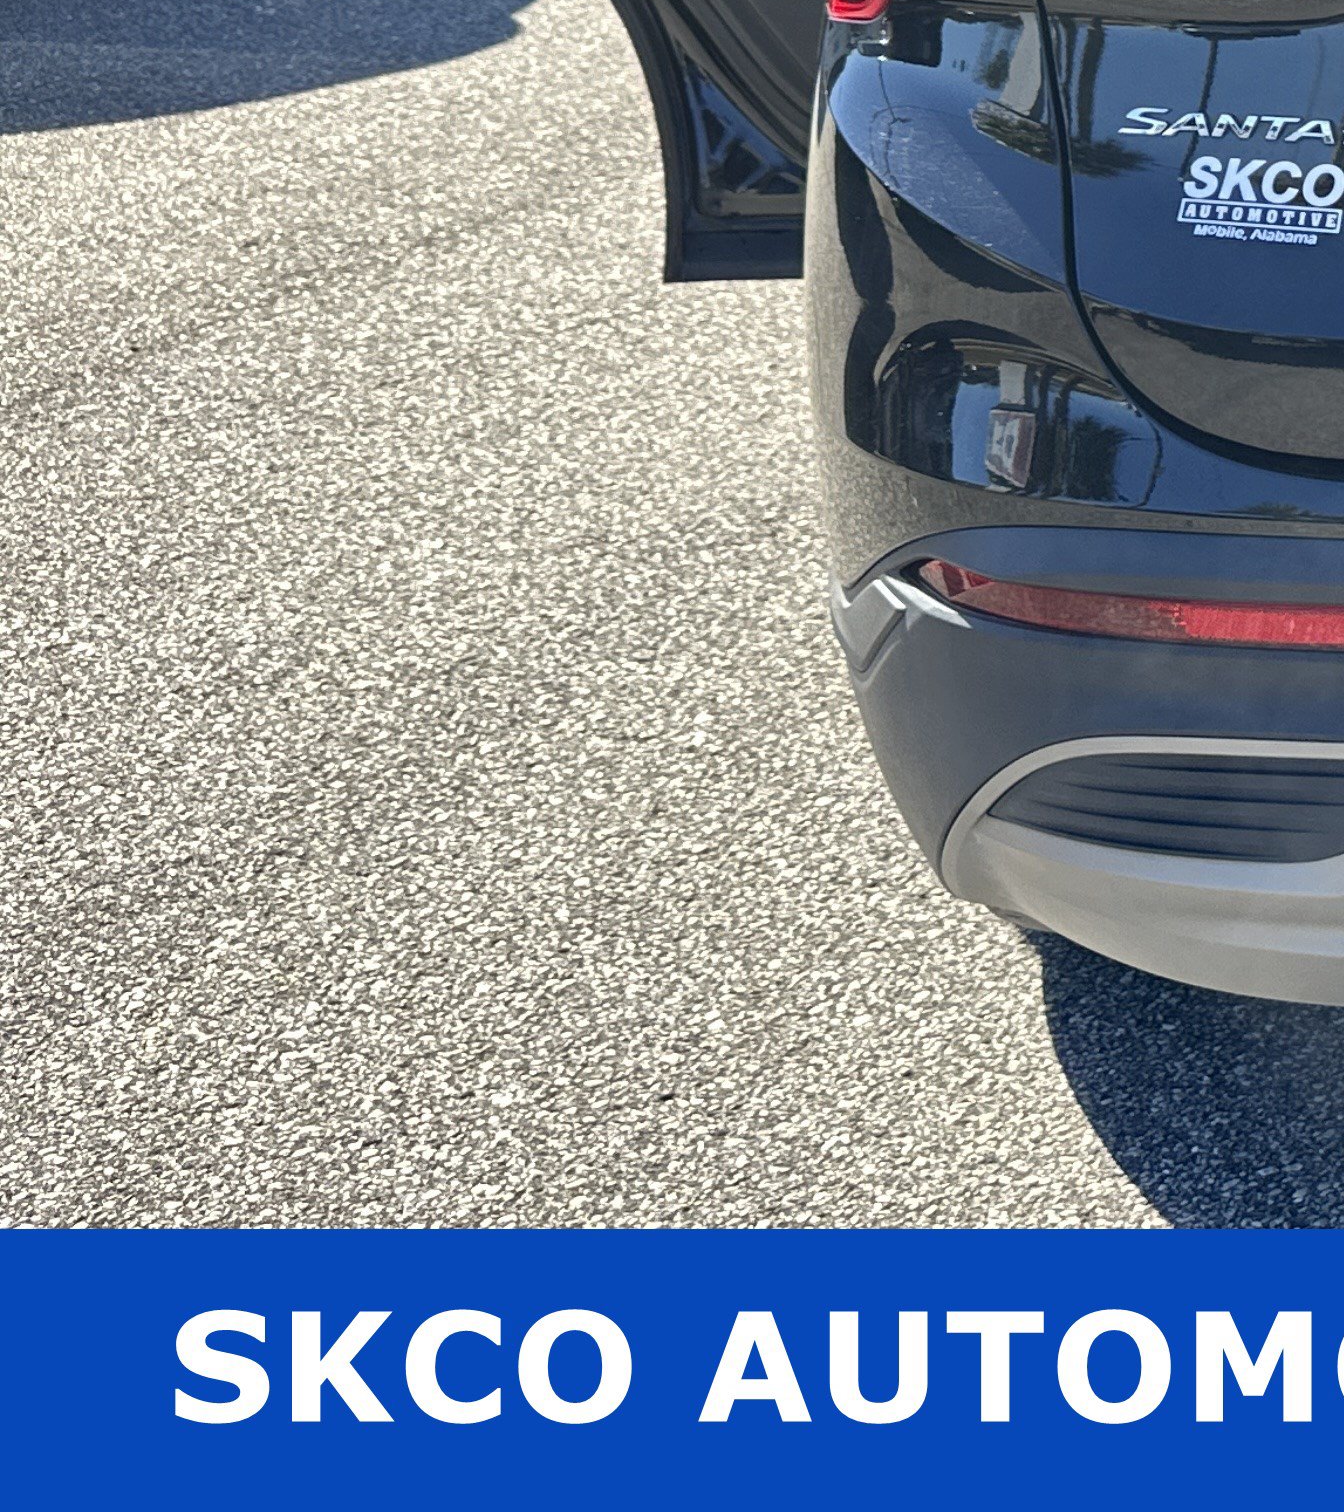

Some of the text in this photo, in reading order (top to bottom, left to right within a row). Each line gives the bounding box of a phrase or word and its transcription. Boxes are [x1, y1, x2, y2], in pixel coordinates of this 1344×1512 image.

[1183, 202, 1339, 229] AUTOMOTIVE
[1193, 224, 1319, 245] Mobile, Alabama
